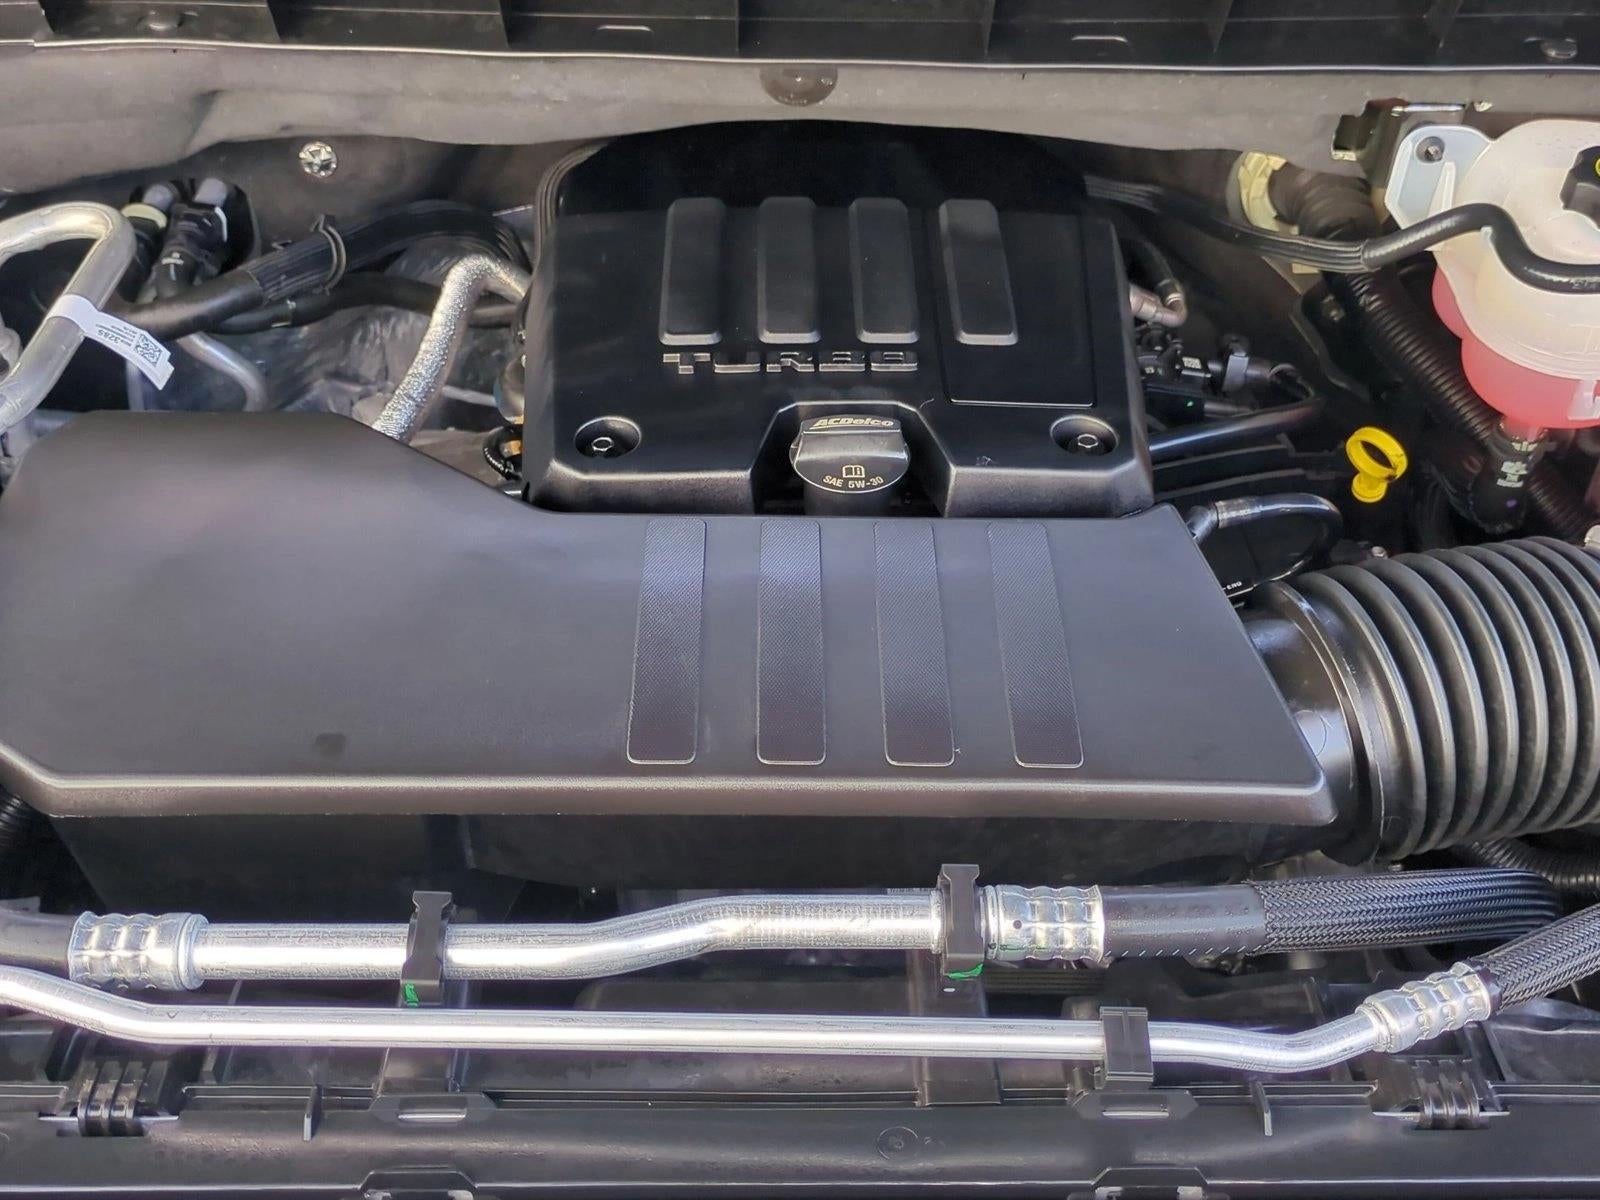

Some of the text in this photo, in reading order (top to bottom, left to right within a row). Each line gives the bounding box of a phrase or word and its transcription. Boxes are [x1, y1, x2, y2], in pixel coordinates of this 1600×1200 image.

[662, 351, 918, 374] TURBO
[809, 417, 894, 429] ACDelco
[823, 475, 884, 488] SAE 5W-30
